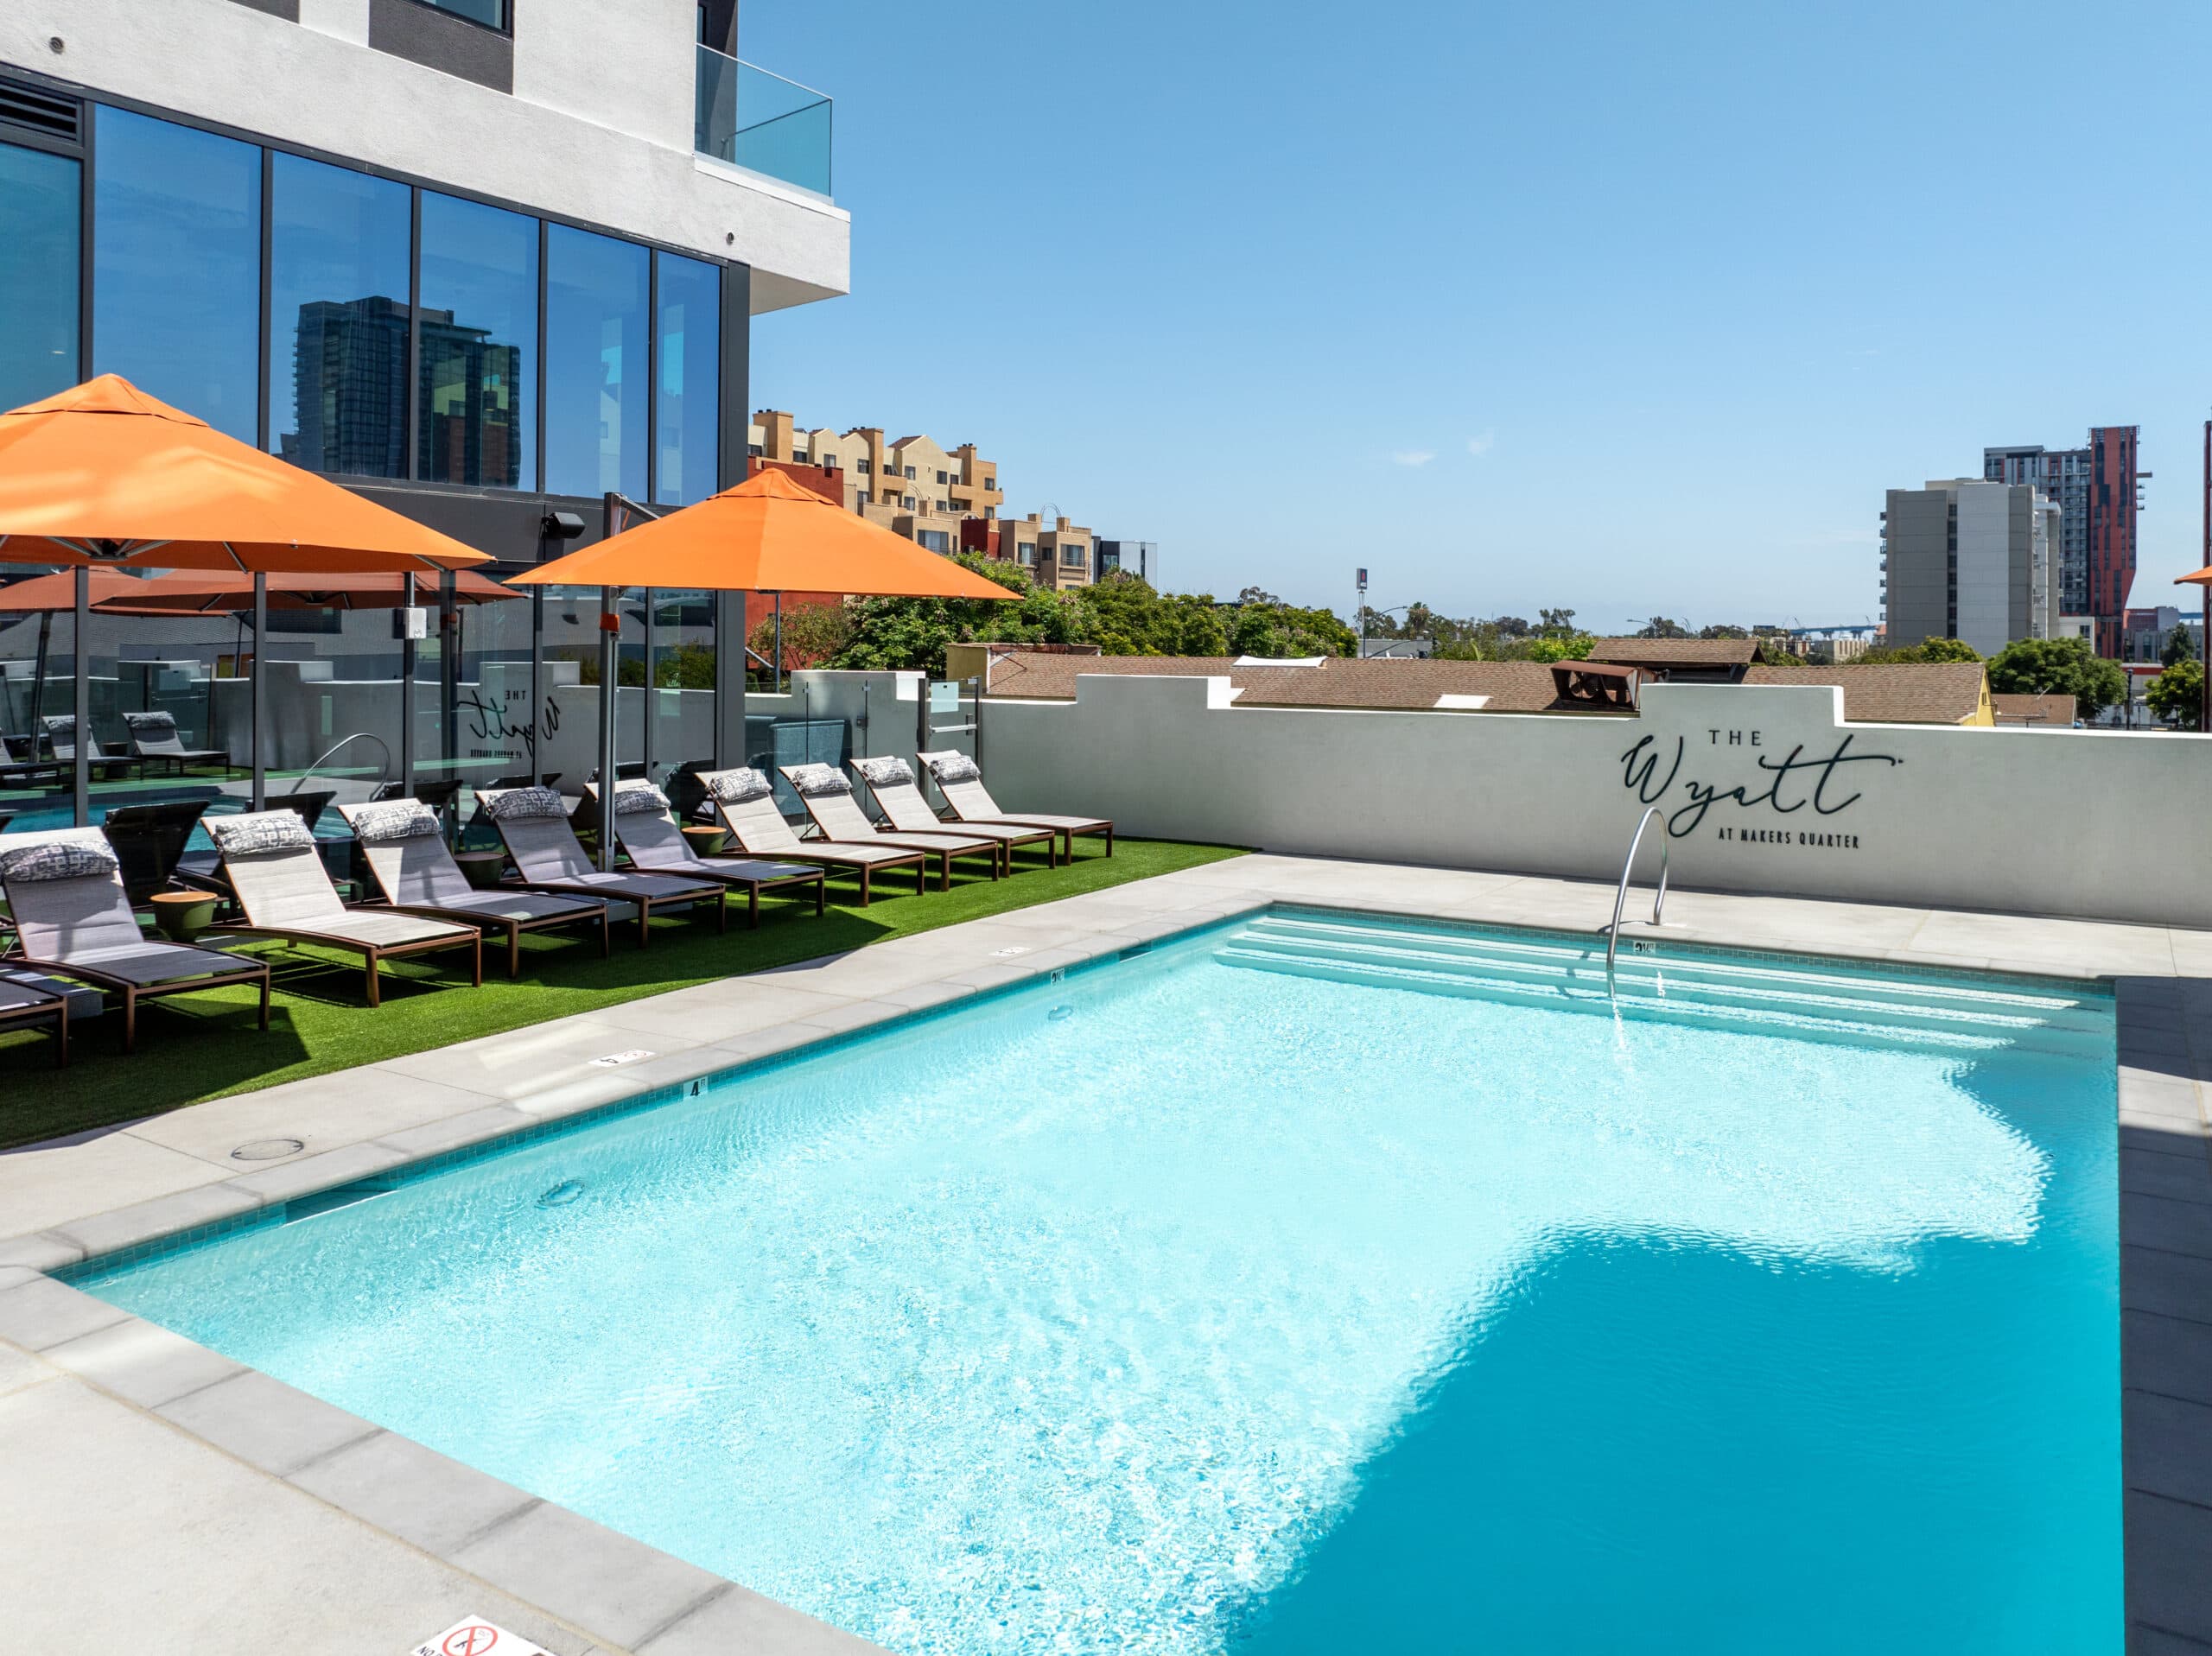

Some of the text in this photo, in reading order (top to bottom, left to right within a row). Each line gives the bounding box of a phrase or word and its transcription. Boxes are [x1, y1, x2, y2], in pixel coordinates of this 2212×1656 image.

[1707, 729, 1763, 746] THE
[1620, 733, 1899, 838] Wyatt
[1718, 827, 1859, 849] AT MAKERS QUARTER
[690, 1081, 700, 1096] 4
